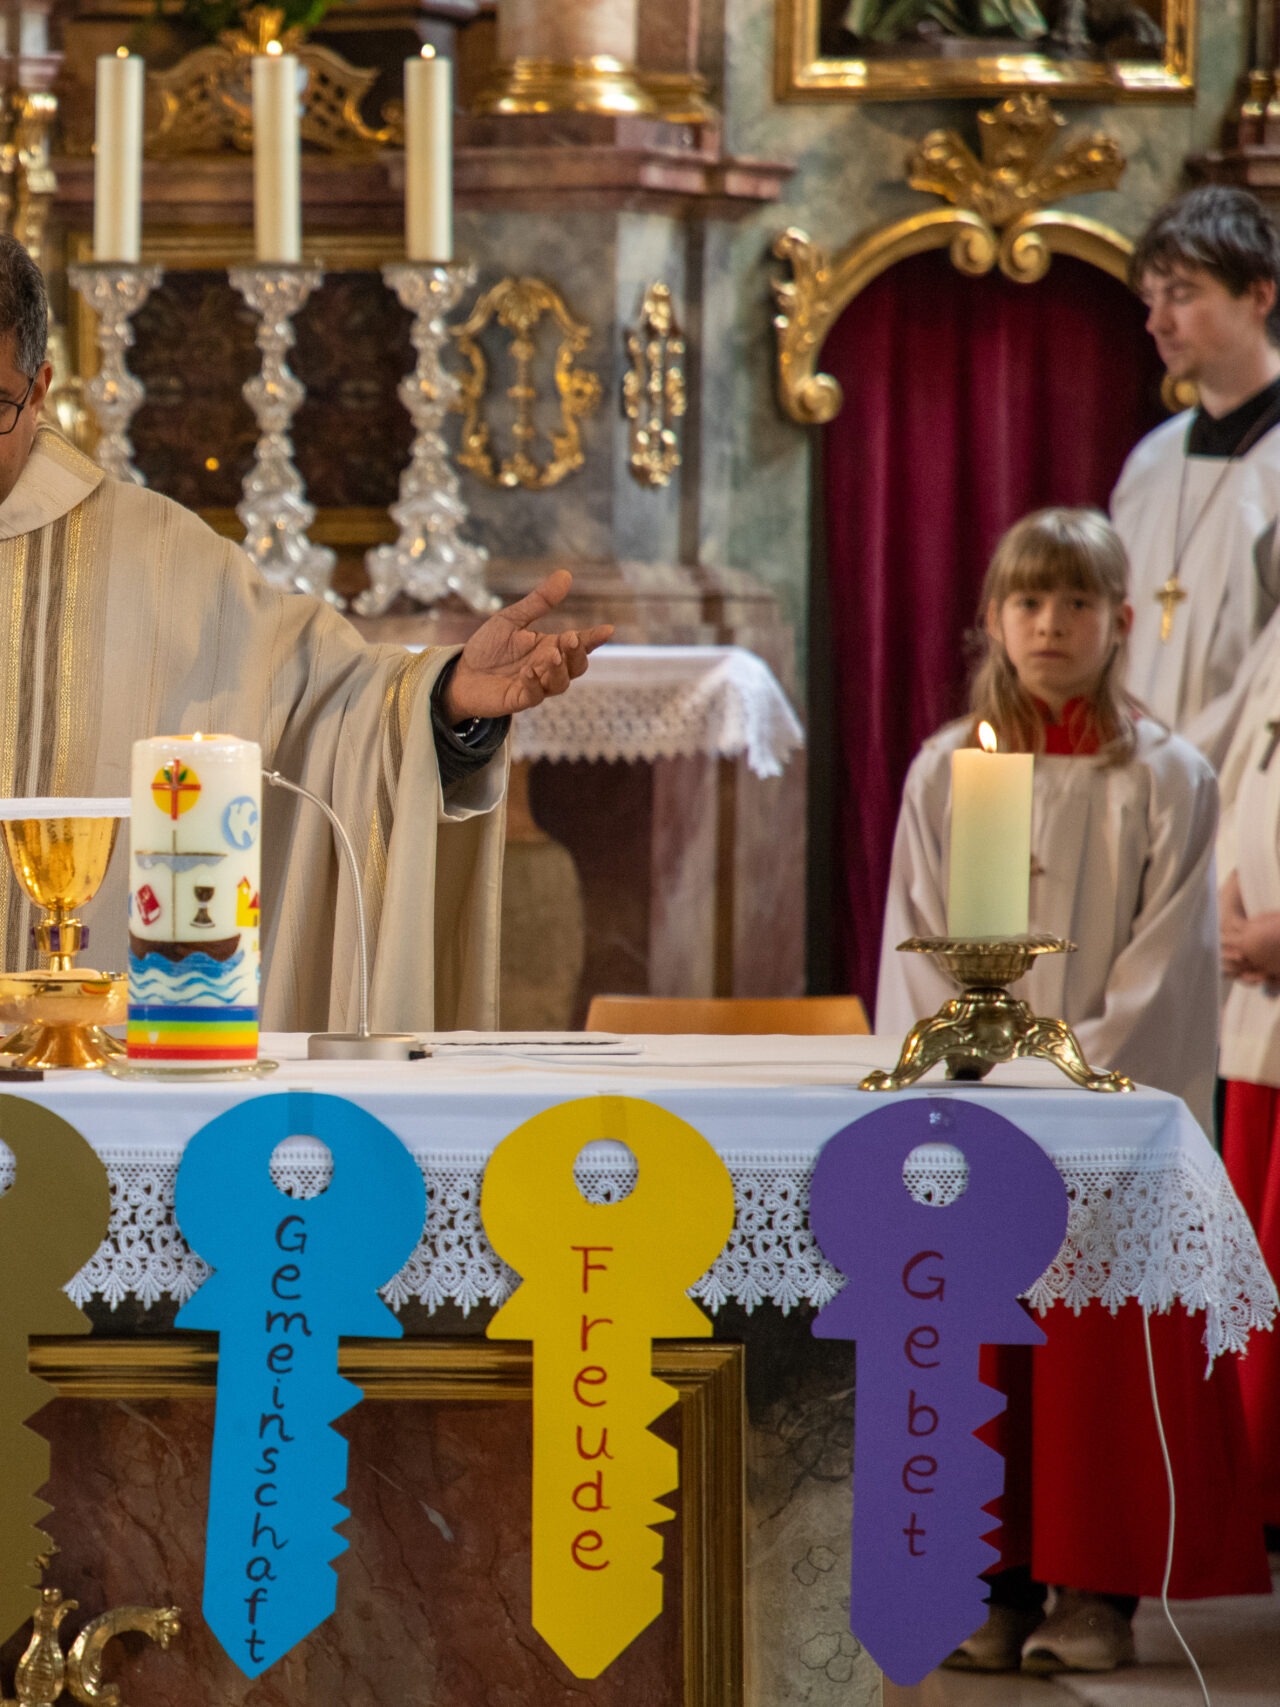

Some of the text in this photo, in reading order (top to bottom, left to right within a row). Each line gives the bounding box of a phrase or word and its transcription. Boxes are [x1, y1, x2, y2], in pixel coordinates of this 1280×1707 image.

[244, 1215, 313, 1665] Gemeinschaft
[570, 1246, 615, 1571] Freude
[901, 1251, 946, 1558] Gebet
